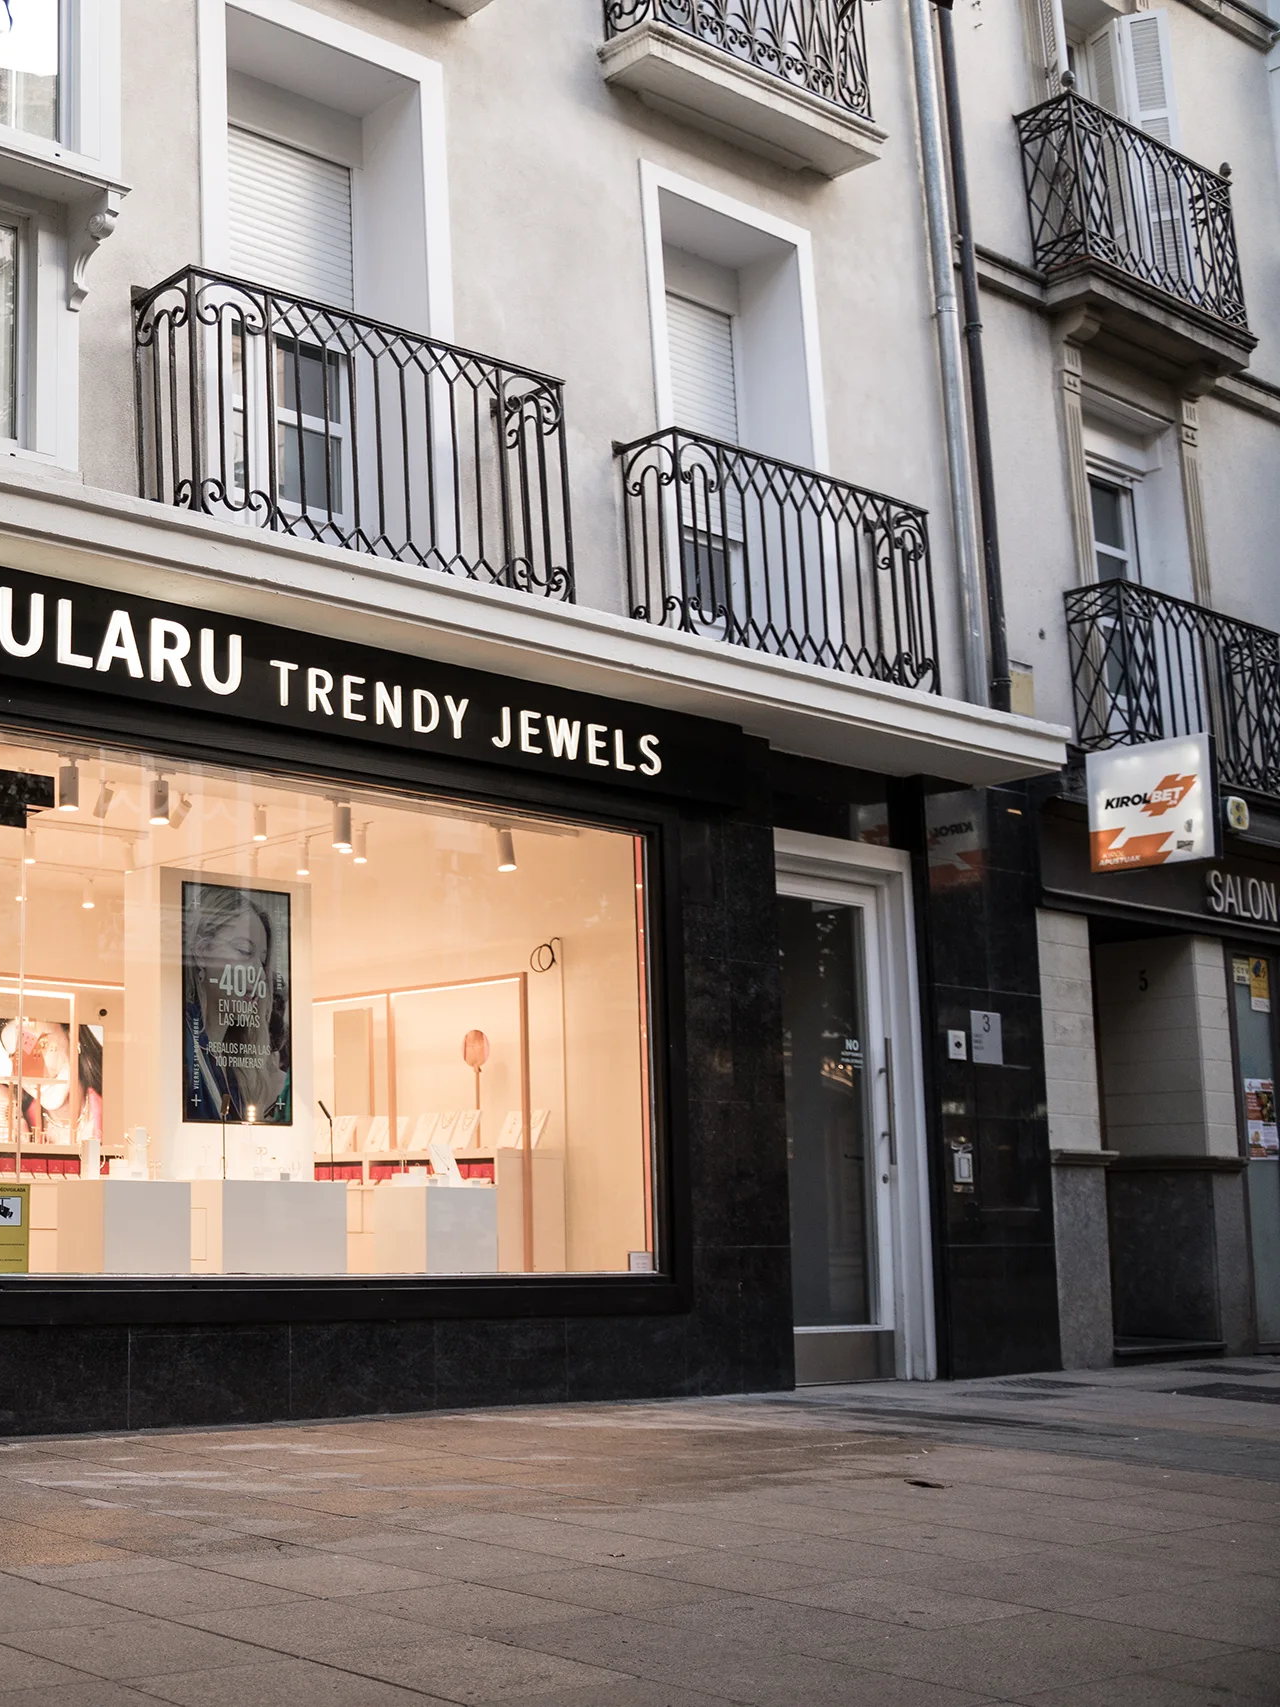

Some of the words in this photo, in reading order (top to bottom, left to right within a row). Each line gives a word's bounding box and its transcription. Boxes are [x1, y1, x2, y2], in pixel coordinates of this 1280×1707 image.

[270, 660, 469, 740] TRENDY
[491, 706, 662, 776] JEWELS
[1105, 786, 1184, 810] KIROLBET
[1209, 870, 1278, 922] SALON
[209, 964, 267, 999] -40%
[1139, 969, 1148, 991] 5
[218, 999, 230, 1013] EN
[232, 1000, 258, 1015] TODAS
[218, 1013, 235, 1027] LAS
[236, 1014, 261, 1029] JOYAS
[982, 1014, 991, 1033] 3
[206, 1041, 239, 1055] ¡REGALOS
[239, 1044, 256, 1056] PARA
[258, 1045, 272, 1056] LAS
[845, 1039, 859, 1051] NO
[215, 1055, 228, 1067] 100
[228, 1057, 265, 1069] PRIMERAS!
